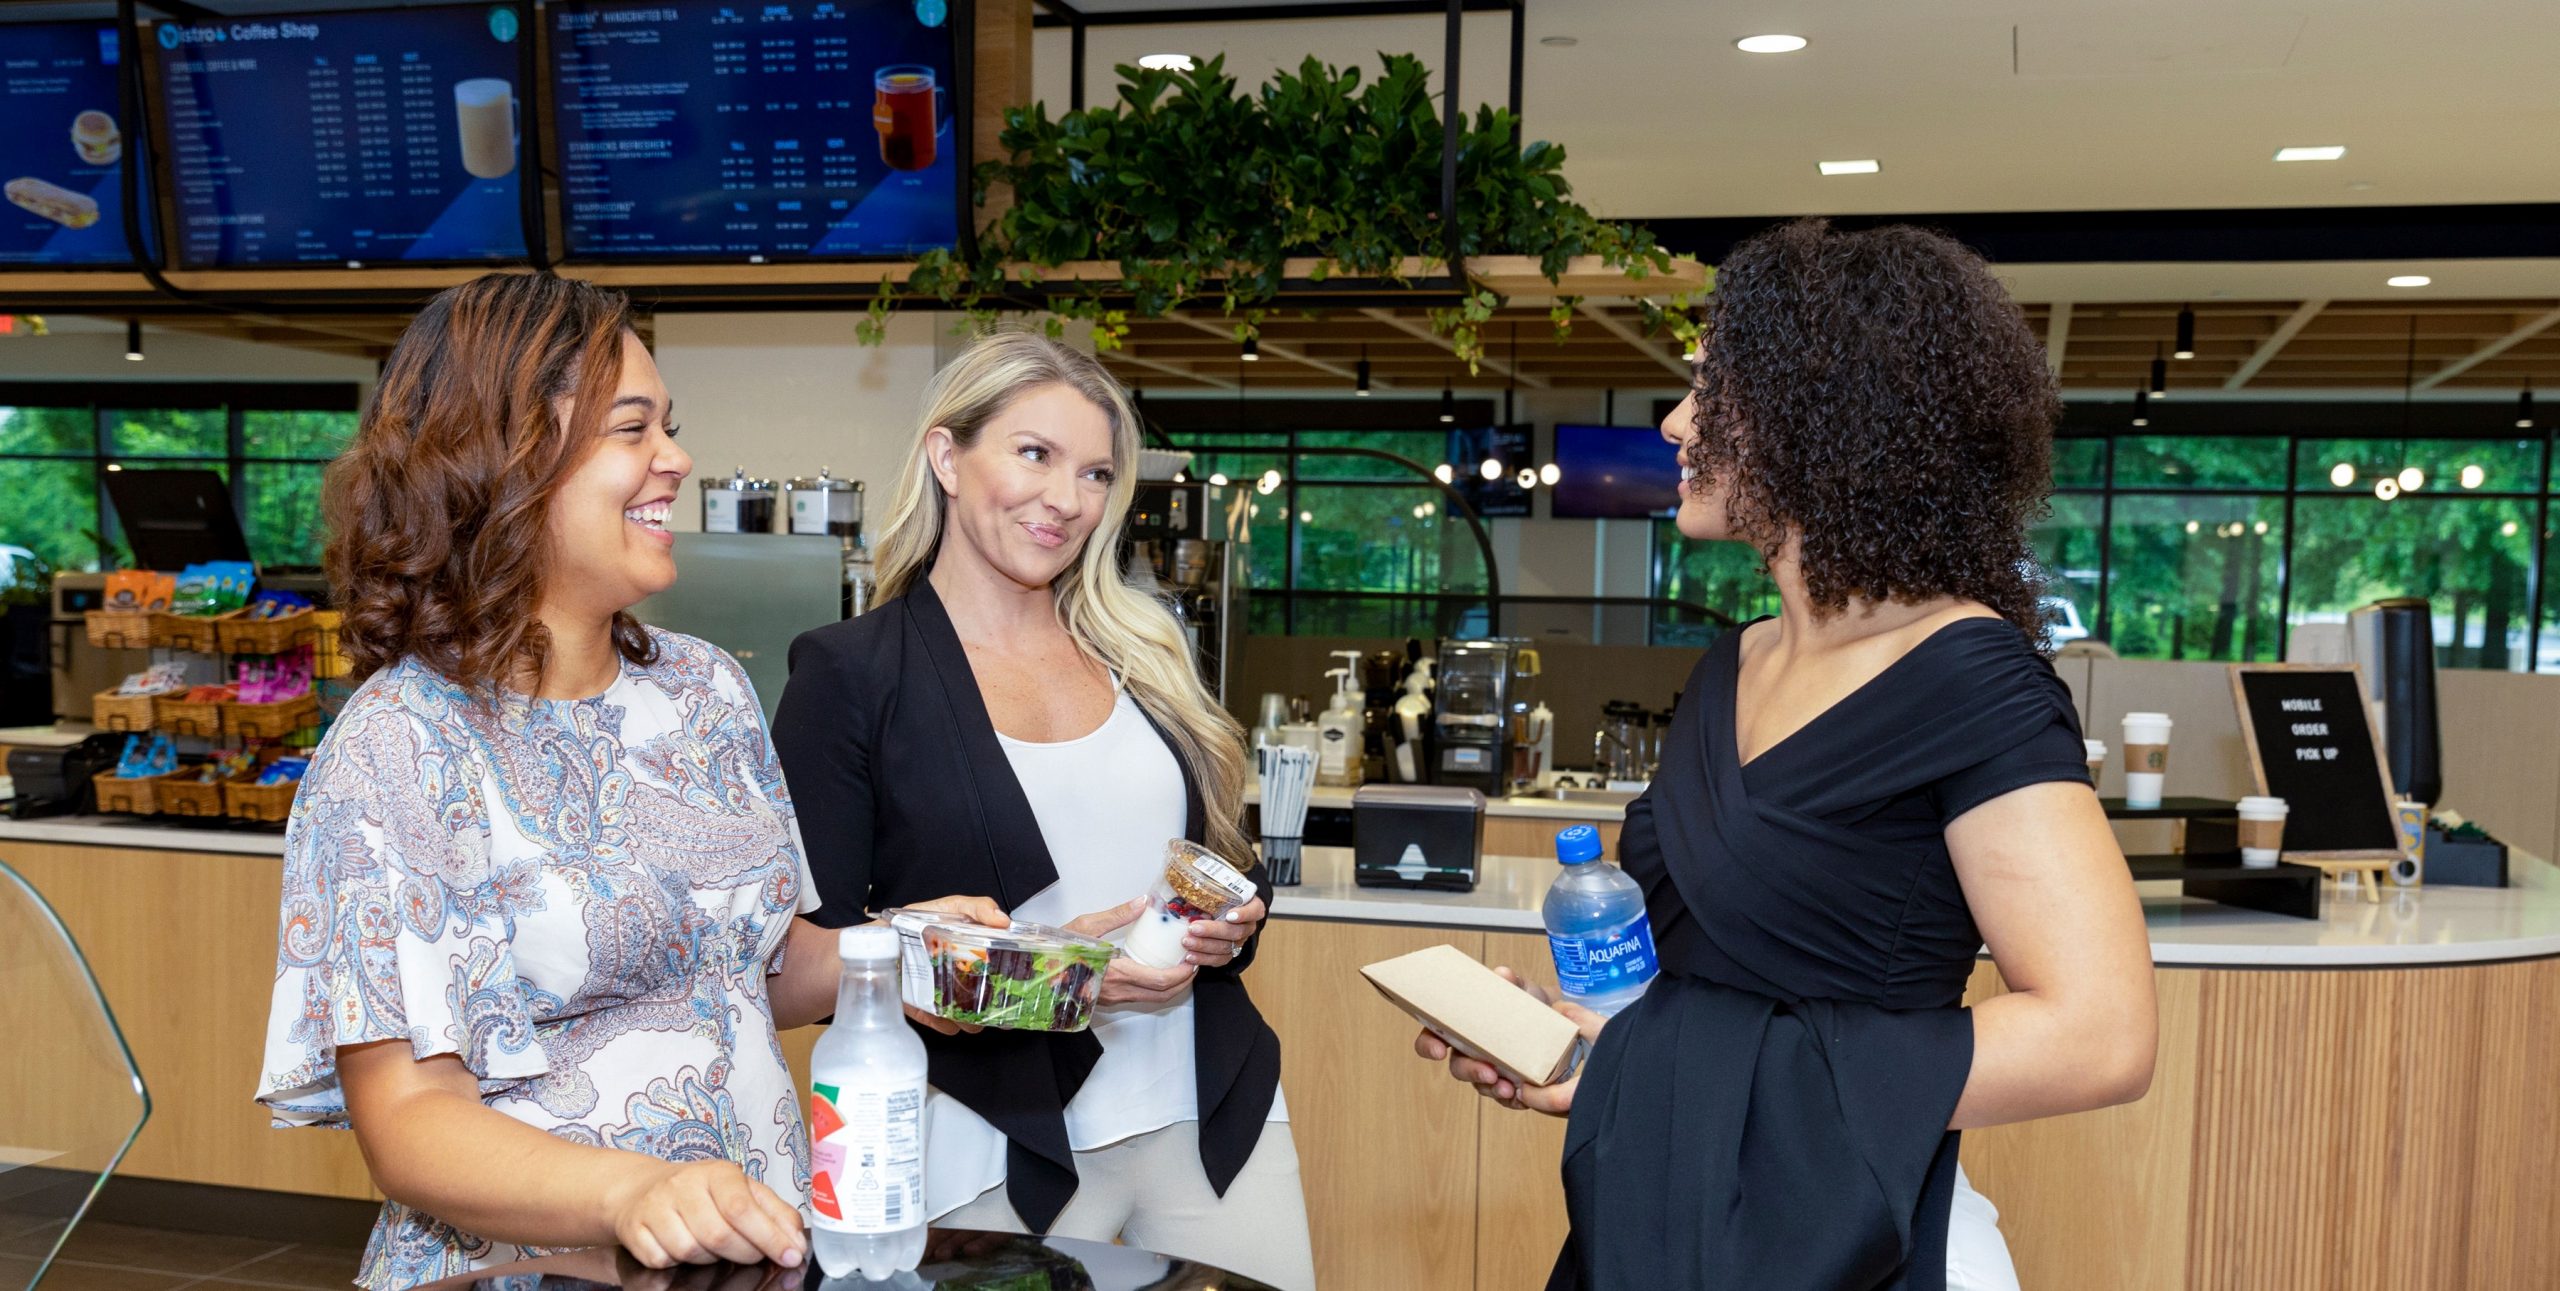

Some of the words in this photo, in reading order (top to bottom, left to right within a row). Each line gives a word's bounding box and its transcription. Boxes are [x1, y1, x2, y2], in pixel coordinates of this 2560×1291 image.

[230, 23, 279, 41] Coffee
[280, 21, 320, 40] Shop
[2281, 699, 2322, 711] MOBILE
[2291, 723, 2328, 735] ORDER
[2296, 748, 2320, 760] PICK
[2323, 748, 2338, 760] UP
[1589, 936, 1642, 965] AQUAFINA
